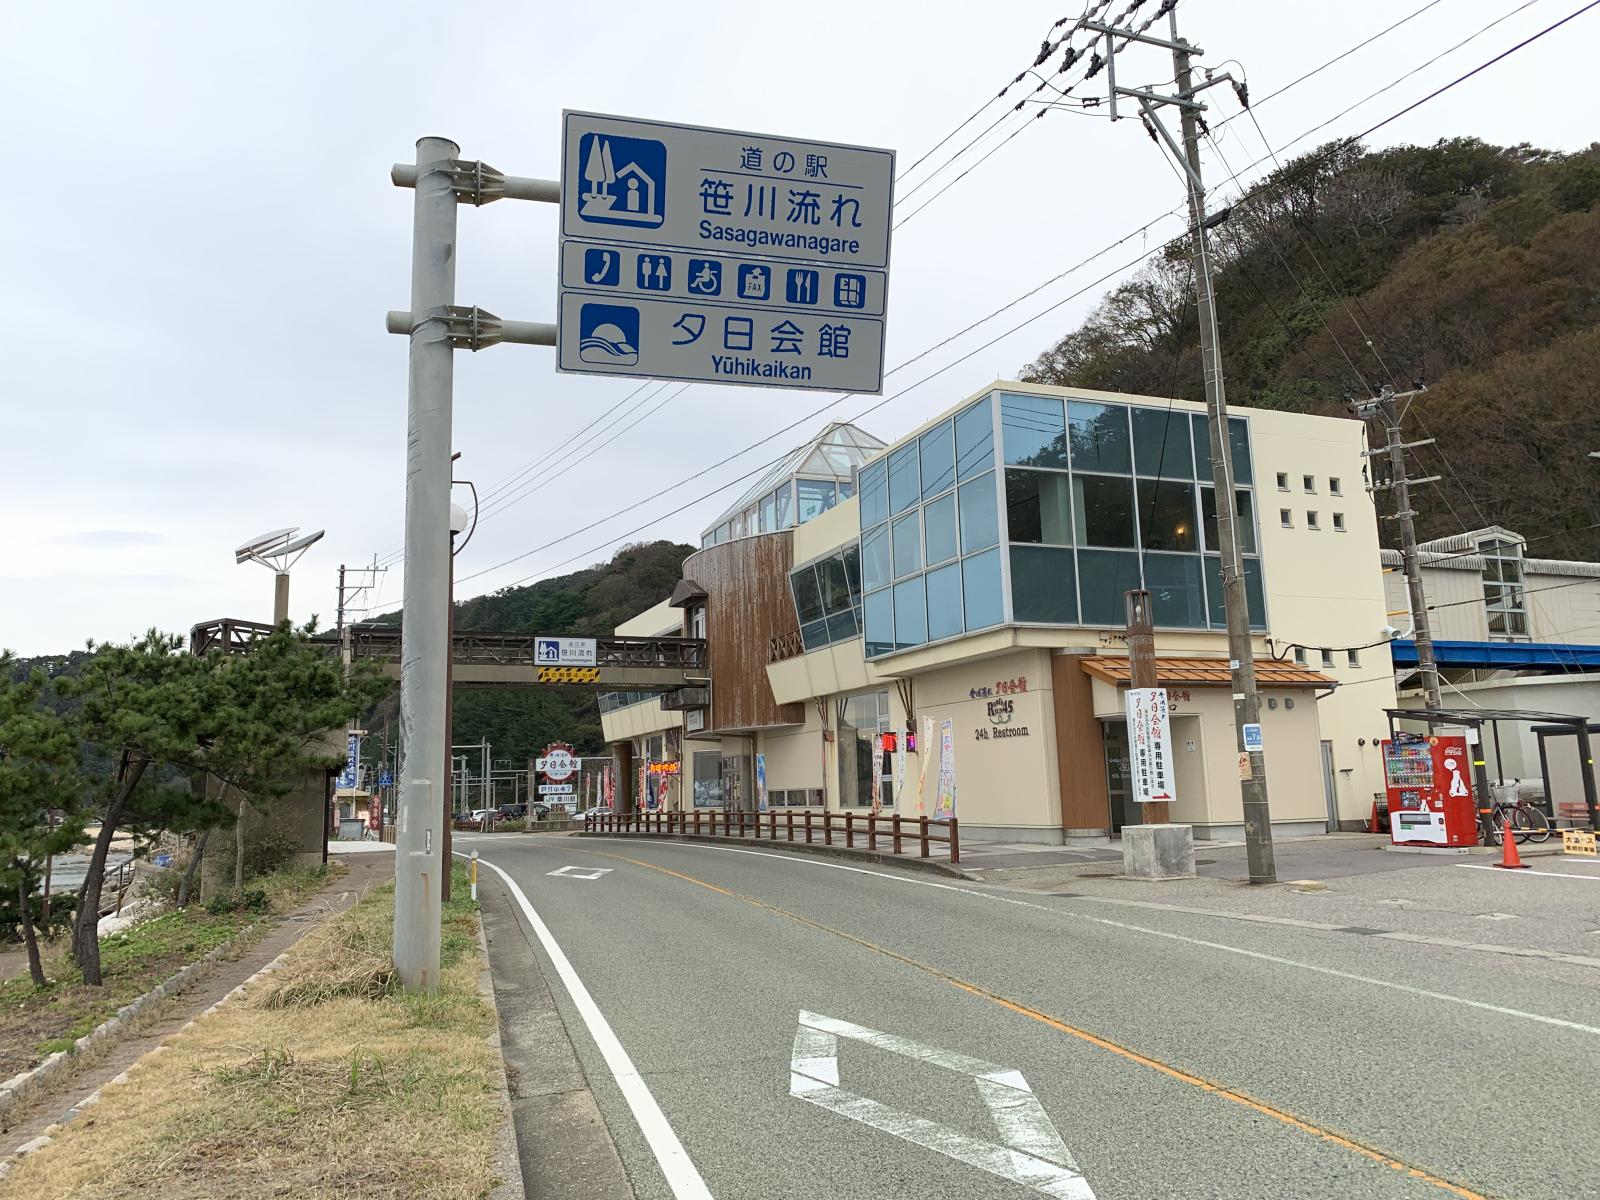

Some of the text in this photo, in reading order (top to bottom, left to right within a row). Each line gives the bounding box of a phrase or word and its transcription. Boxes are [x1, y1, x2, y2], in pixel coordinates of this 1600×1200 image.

[740, 146, 828, 179] 道の駅
[699, 178, 862, 228] 笹川流れ
[699, 220, 860, 254] Sasagawanagare
[747, 281, 762, 293] FAX
[672, 313, 851, 359] 夕日会館
[711, 355, 812, 380] Yūhikaikan
[974, 725, 1030, 741] 24h Restroom
[1135, 697, 1146, 746] 夕日会館
[1150, 692, 1166, 790] 夕日会館 専用駐車場
[540, 759, 578, 770] 夕日会館
[1139, 748, 1150, 797] 専用駐車場
